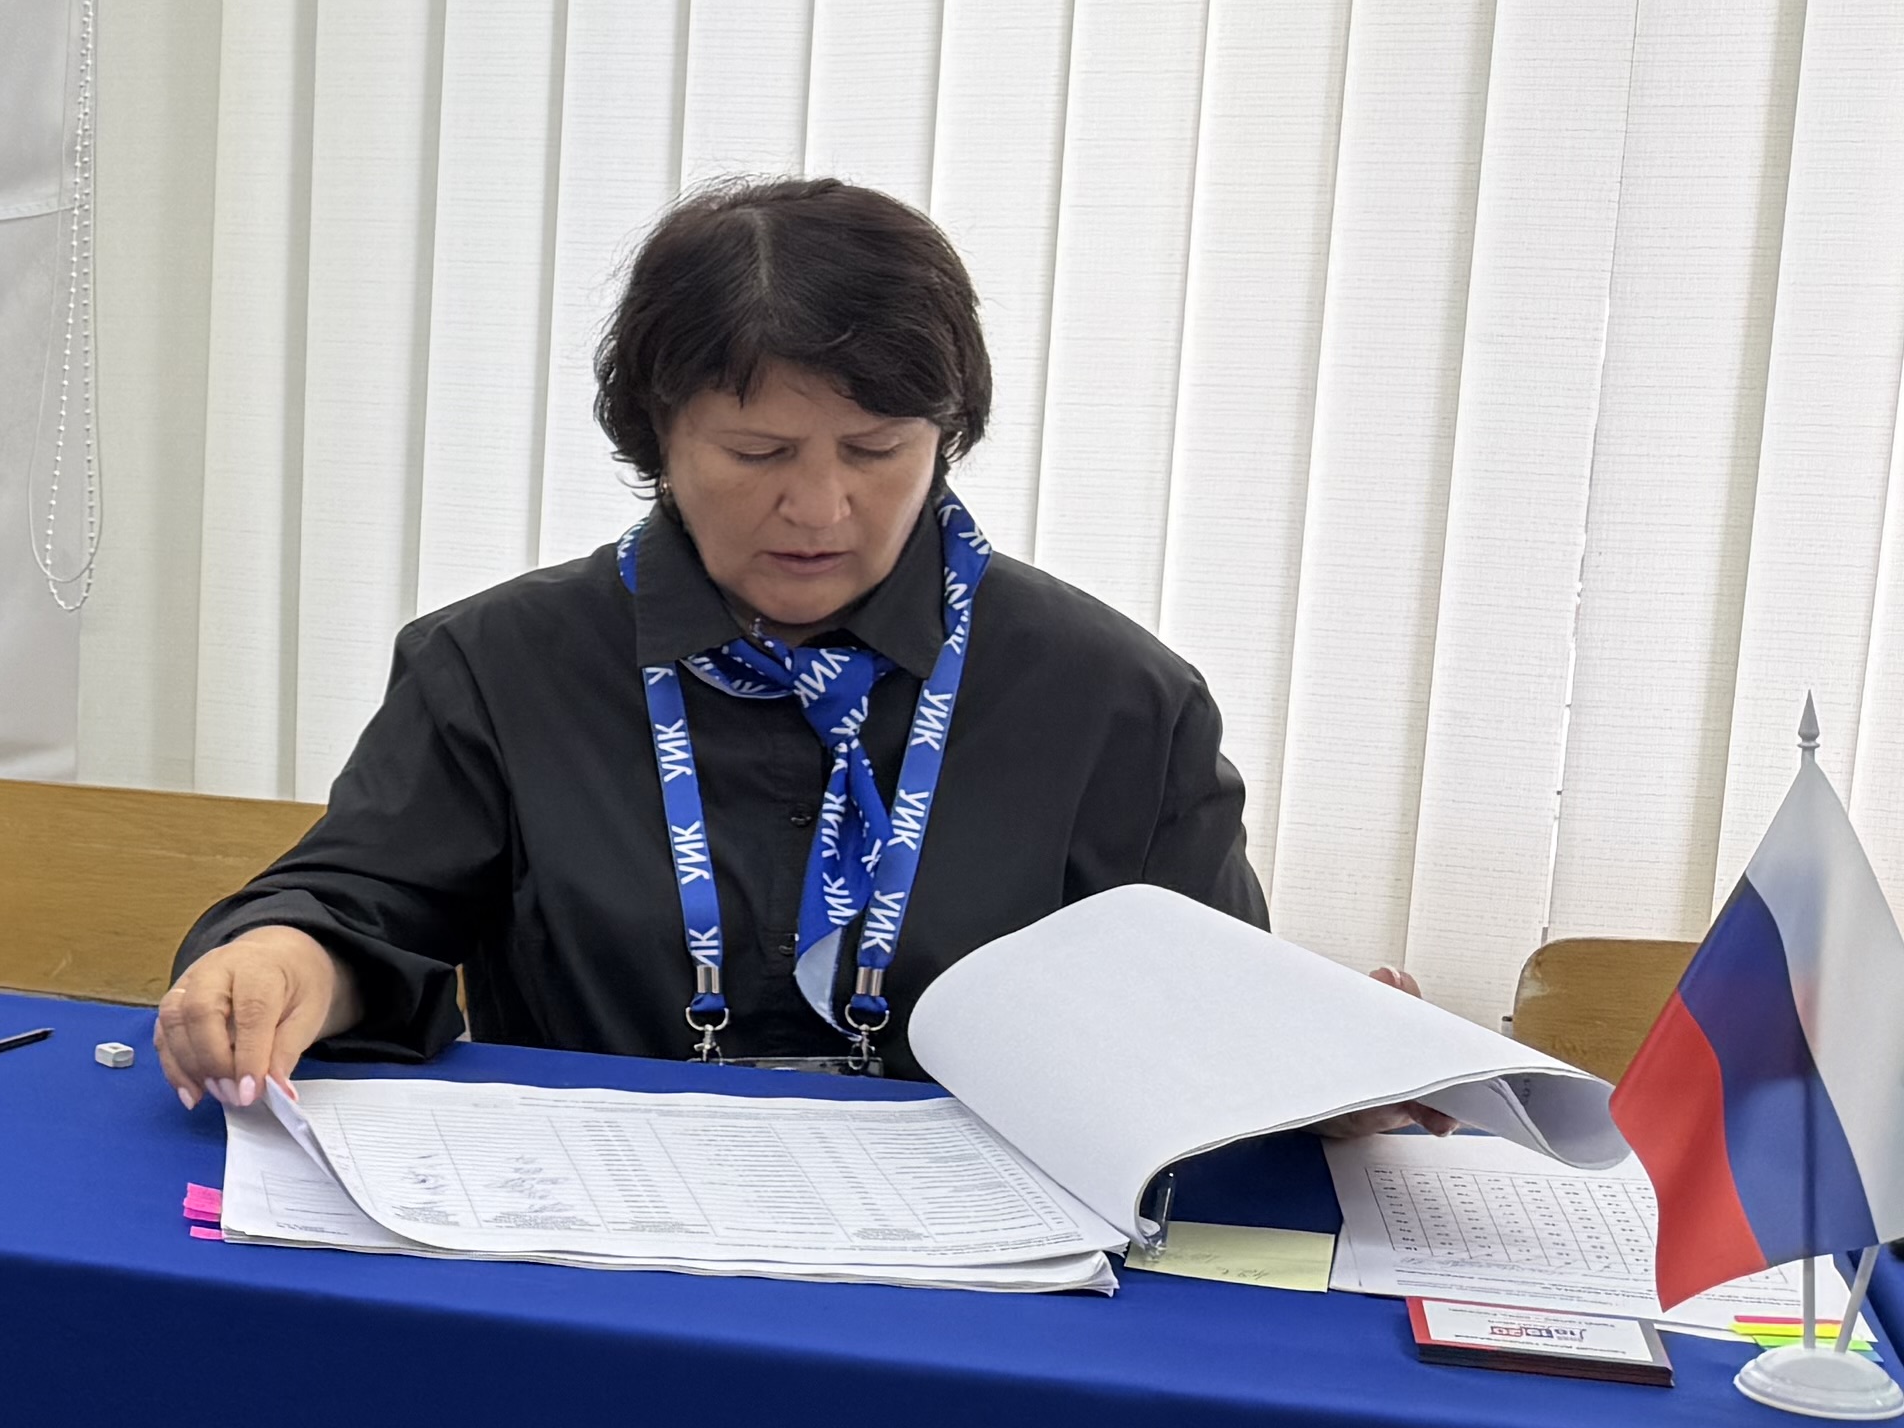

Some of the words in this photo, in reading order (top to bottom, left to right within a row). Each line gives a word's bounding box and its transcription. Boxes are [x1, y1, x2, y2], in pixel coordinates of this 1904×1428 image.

[793, 649, 850, 708] УИК
[654, 719, 692, 783] УИК
[911, 689, 952, 751] УИК
[822, 791, 847, 860] УИК
[888, 790, 929, 850] УИК
[672, 821, 709, 884] УИК
[861, 890, 905, 953] УИК
